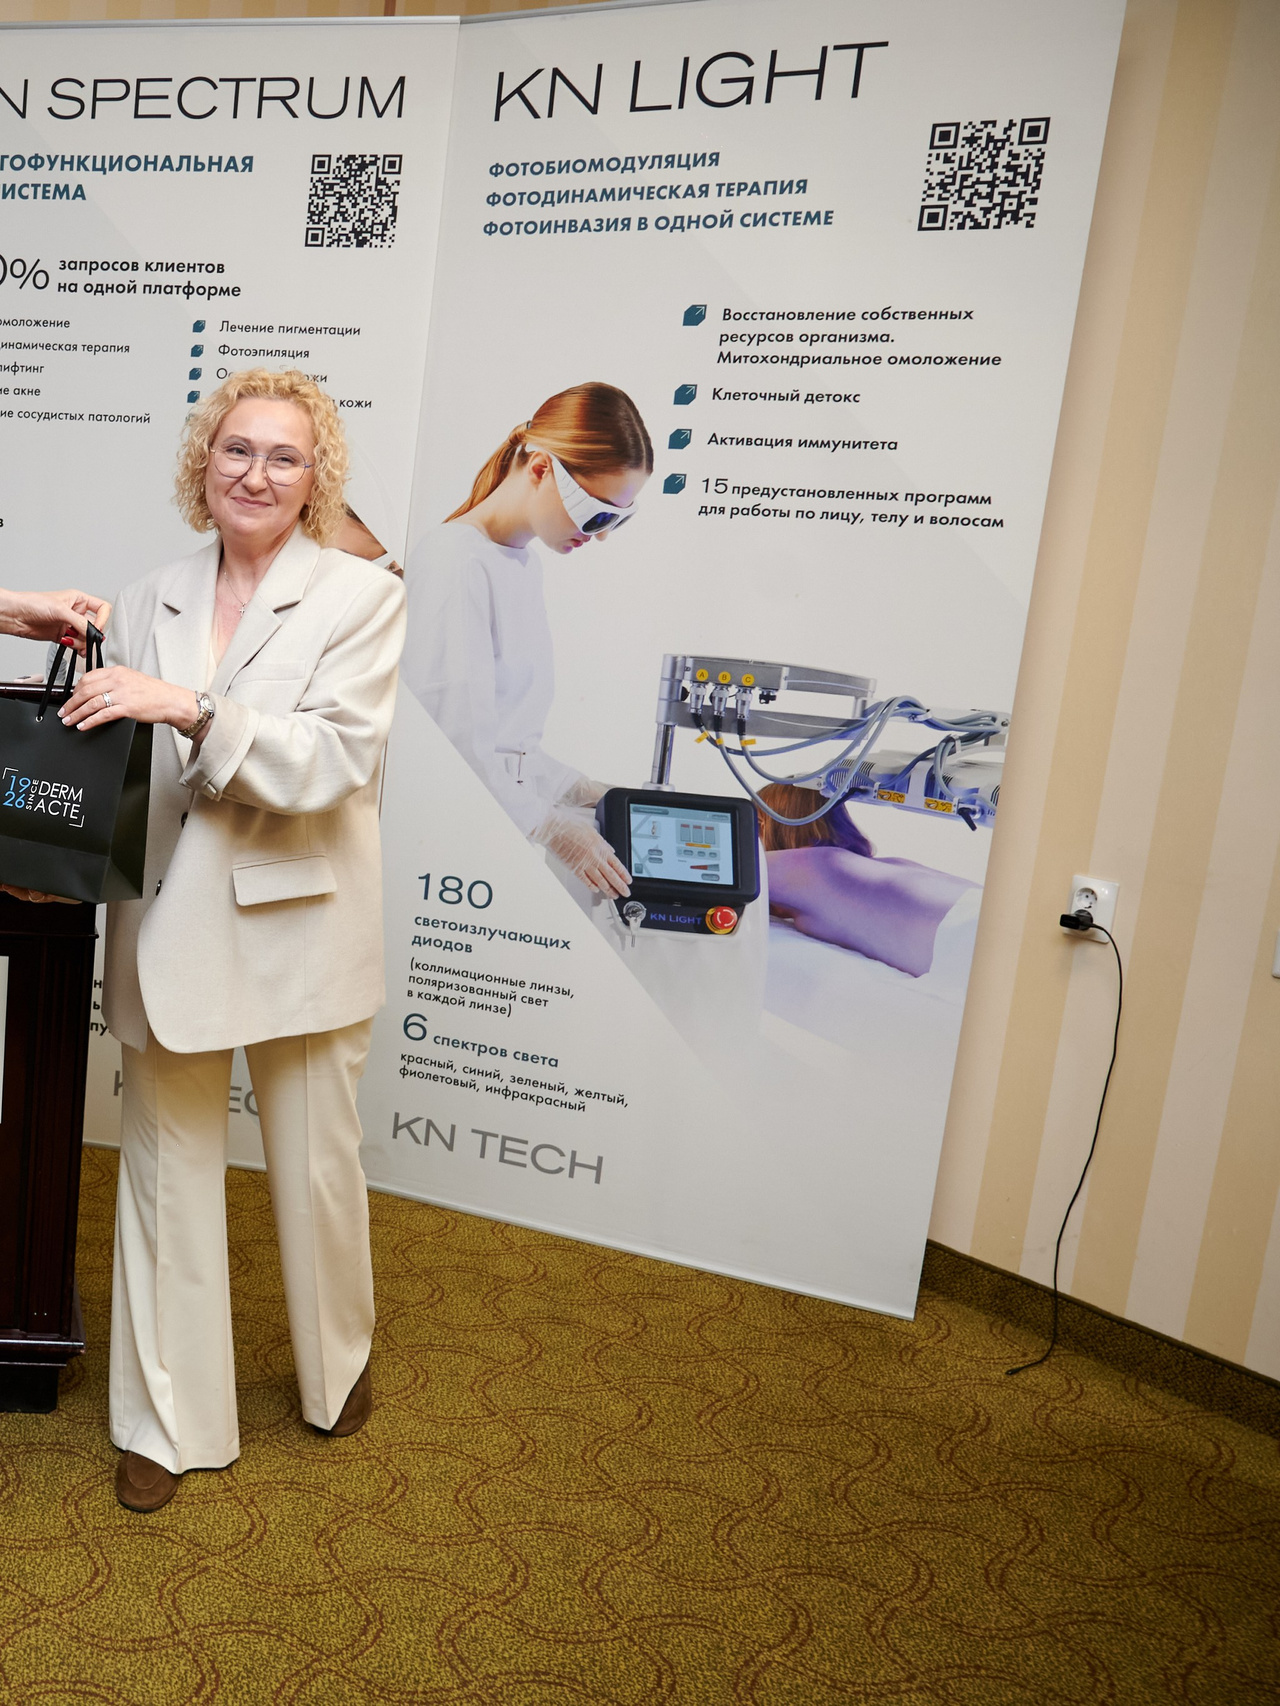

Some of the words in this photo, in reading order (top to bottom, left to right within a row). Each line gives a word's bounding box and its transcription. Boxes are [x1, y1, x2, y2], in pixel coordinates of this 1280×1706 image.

[493, 63, 604, 122] KN
[629, 40, 890, 113] LIGHT
[46, 75, 406, 121] SPECTRUM
[488, 151, 721, 178] ФОТОБИОМОДУЛЯЦИЯ
[485, 183, 710, 208] ФОТОДИНАМИЧЕСКАЯ
[715, 178, 809, 198] ТЕРАПИЯ
[482, 216, 632, 237] ФОТОИНВАЗИЯ
[636, 216, 649, 231] В
[654, 208, 735, 234] ОДНОЙ
[739, 209, 835, 228] СИСТЕМЕ
[58, 259, 140, 276] запросов
[144, 261, 225, 274] клиентов
[57, 282, 78, 293] на
[83, 279, 137, 297] одной
[142, 280, 242, 301] платформе
[722, 307, 857, 322] Восстановление
[860, 305, 974, 321] собственных
[219, 320, 275, 334] Лечение
[277, 325, 361, 338] пигментации
[718, 333, 794, 347] ресурсов
[798, 333, 895, 347] организма.
[80, 344, 130, 356] терапия
[217, 343, 310, 360] Фотоэпиляция
[716, 350, 883, 369] Митохондриальное
[887, 355, 1002, 366] омоложение
[12, 387, 41, 397] акне
[339, 399, 373, 409] кожи
[712, 387, 801, 402] Клеточный
[803, 393, 861, 405] детокс
[17, 410, 85, 423] сосудистых
[88, 412, 151, 424] патологий
[706, 432, 793, 449] Активация
[797, 438, 898, 453] иммунитета
[701, 477, 729, 495] 15
[731, 485, 899, 502] предустановленных
[904, 492, 992, 508] программ
[697, 505, 726, 517] для
[729, 502, 791, 520] работы
[795, 509, 816, 520] по
[819, 511, 865, 526] лицу,
[870, 513, 910, 528] телу
[913, 514, 925, 525] и
[929, 515, 1004, 528] волосам
[26, 779, 39, 810] SINCE
[38, 781, 83, 802] DERM
[34, 798, 80, 819] ACTE
[417, 872, 494, 910] 180
[650, 913, 666, 922] KN
[669, 914, 702, 925] LIGHT
[411, 935, 473, 954] диодов
[415, 915, 571, 950] светоизлучающих
[410, 957, 526, 988] (коллимационные
[529, 981, 574, 999] линзы,
[408, 974, 517, 1001] поляризованный
[520, 995, 549, 1008] свет
[406, 989, 414, 998] в
[417, 991, 466, 1008] каждой
[468, 1000, 512, 1018] линзе)
[402, 1012, 428, 1042] 6
[433, 1035, 508, 1058] спектров
[512, 1050, 559, 1068] света
[399, 1066, 480, 1092] фиолетовый,
[485, 1083, 586, 1112] инфракрасный
[400, 1053, 457, 1072] красный,
[462, 1064, 504, 1083] синий,
[510, 1073, 569, 1096] зеленый,
[574, 1086, 629, 1107] желтый,
[391, 1111, 457, 1153] KN
[470, 1127, 604, 1185] TECH
